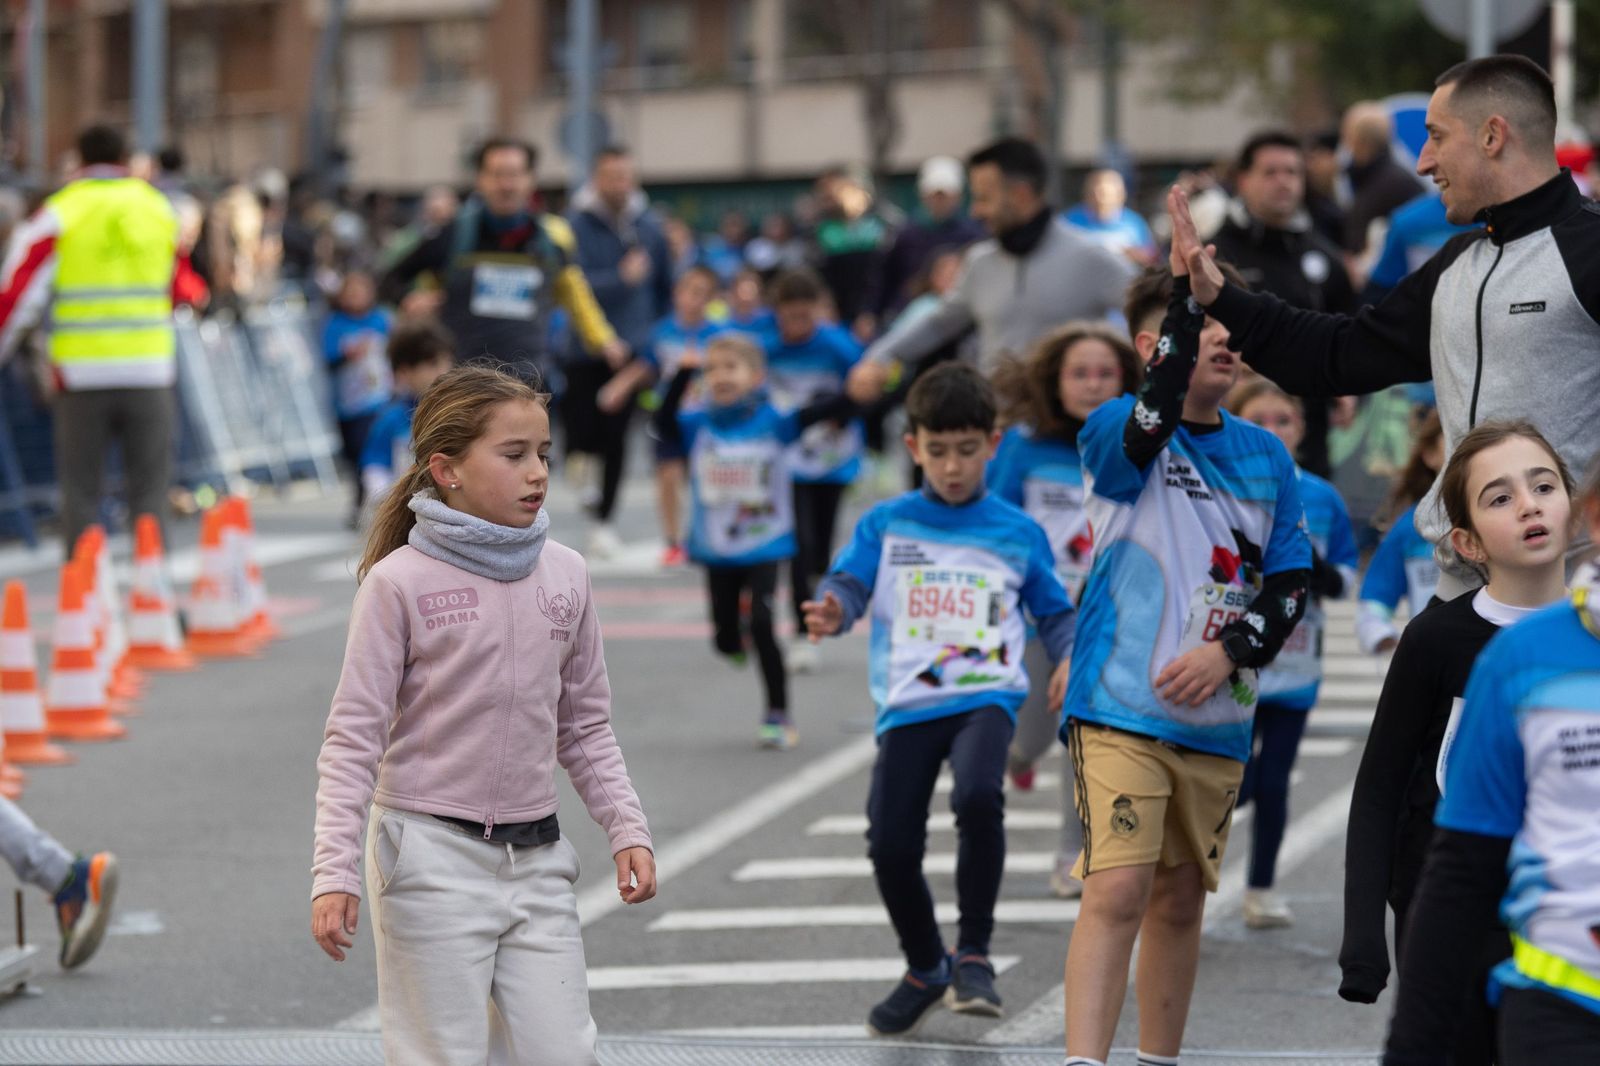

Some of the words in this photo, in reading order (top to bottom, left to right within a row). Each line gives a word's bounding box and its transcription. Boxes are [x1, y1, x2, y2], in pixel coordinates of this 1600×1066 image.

[425, 593, 471, 611] 2002
[908, 587, 976, 619] 6945
[425, 610, 480, 631] OHANA
